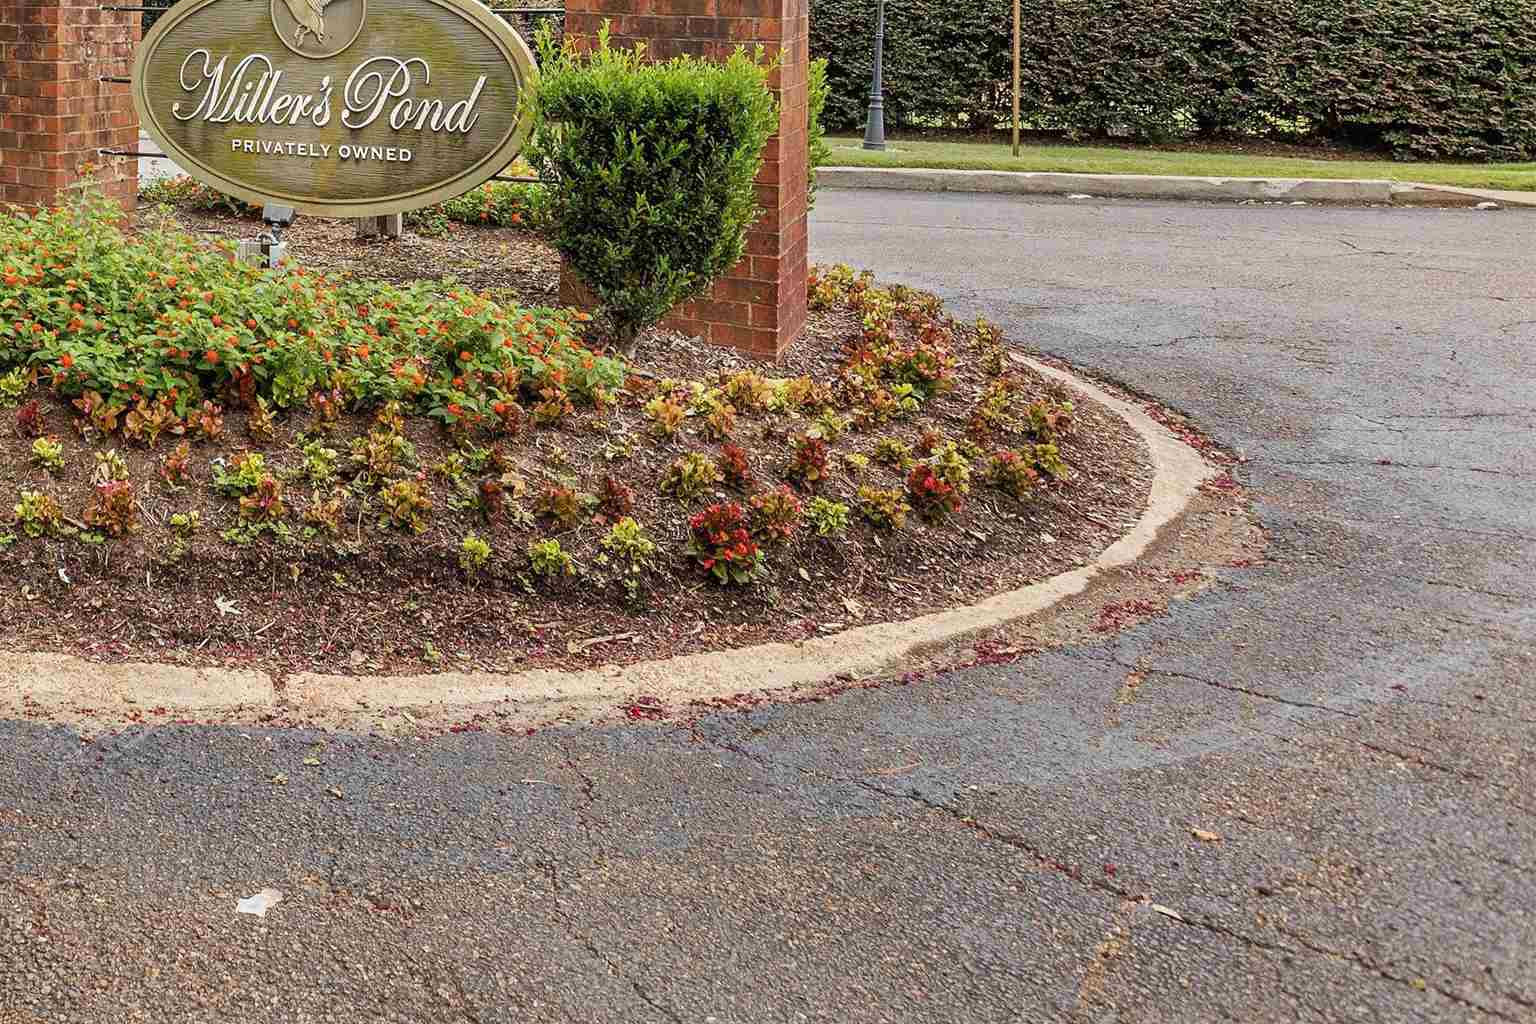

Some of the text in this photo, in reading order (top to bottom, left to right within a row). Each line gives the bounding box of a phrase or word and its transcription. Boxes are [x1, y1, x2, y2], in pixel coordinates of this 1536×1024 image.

[172, 48, 487, 133] Miller's Pond
[232, 139, 412, 162] PRIVATELY OWNED
